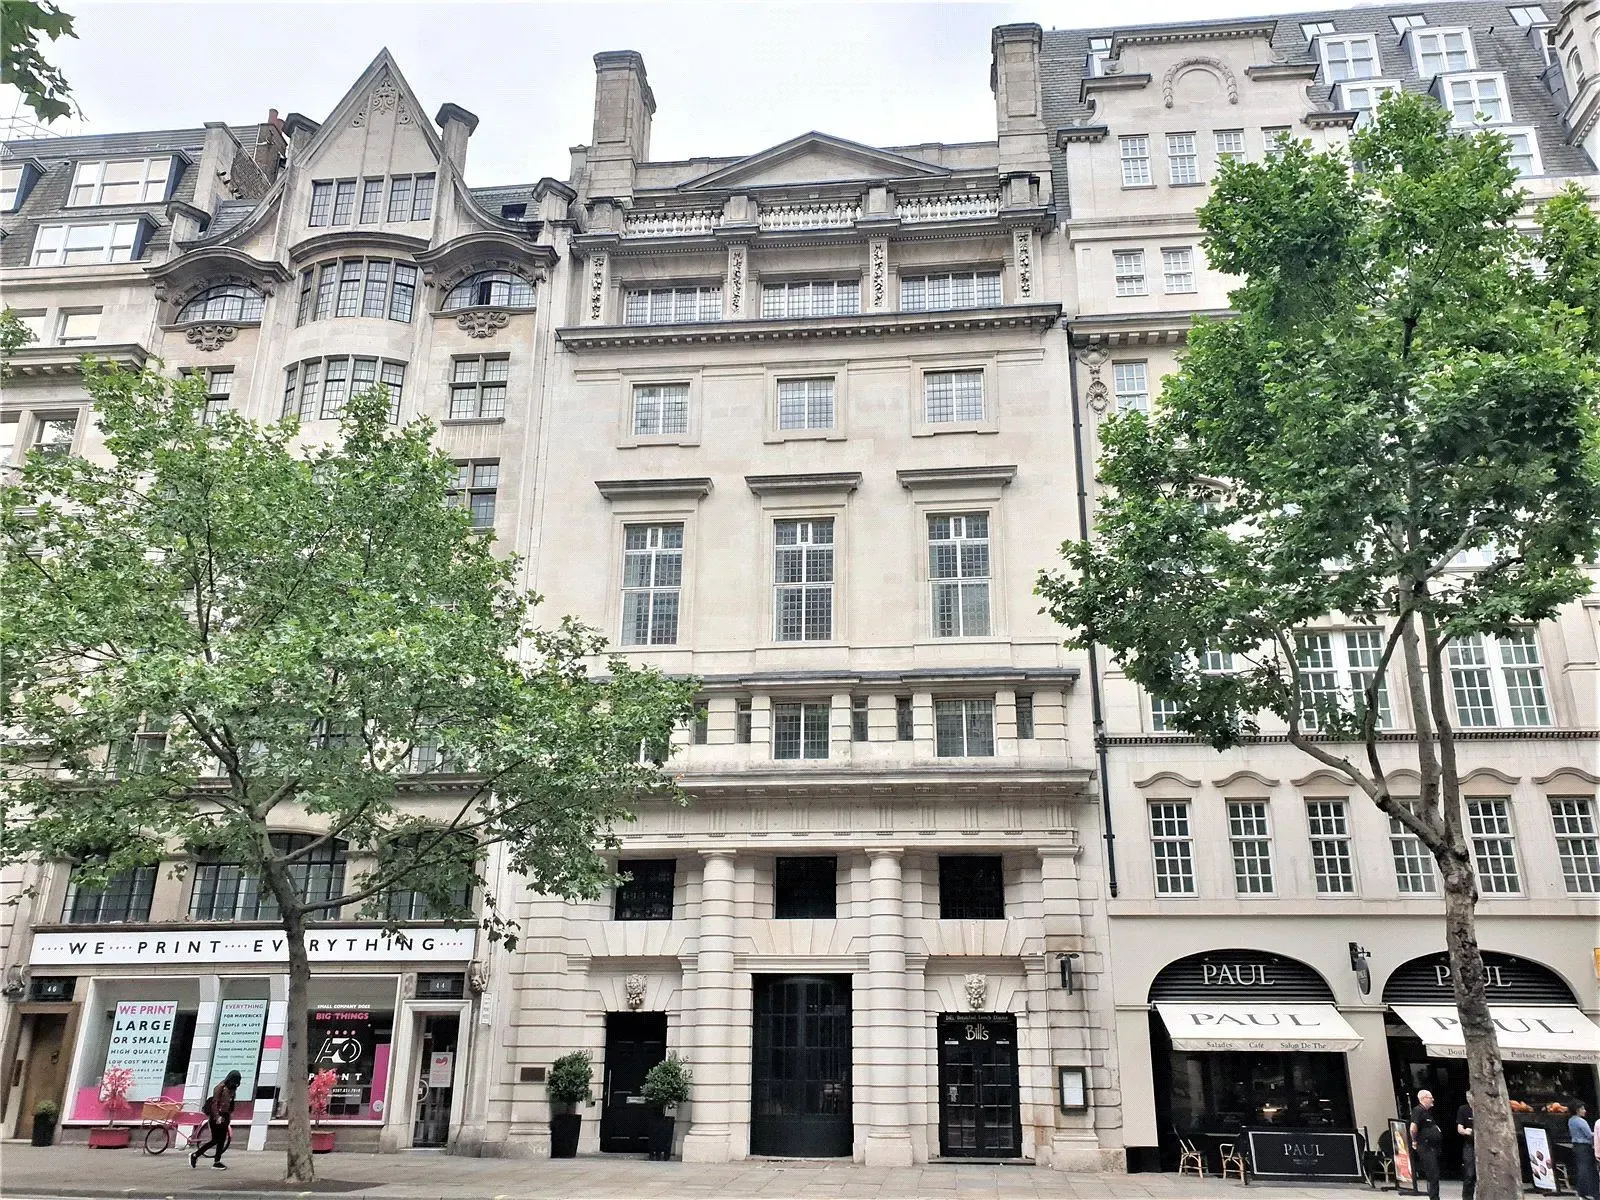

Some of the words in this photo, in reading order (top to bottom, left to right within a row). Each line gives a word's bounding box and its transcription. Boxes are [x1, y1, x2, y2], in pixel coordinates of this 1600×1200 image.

[69, 942, 104, 955] WE
[137, 940, 221, 954] PRINT
[253, 938, 435, 952] EVRYTHING
[1201, 964, 1275, 985] PAUL
[120, 1005, 137, 1015] WE
[139, 1005, 175, 1015] PRINT
[315, 1012, 331, 1020] BIG
[333, 1012, 369, 1020] THINGS
[115, 1020, 172, 1031] LARGE
[1189, 1013, 1321, 1026] PAUL
[1431, 1016, 1574, 1034] PUL
[965, 1023, 989, 1041] Bill's
[113, 1036, 128, 1044] OR
[132, 1036, 169, 1044] SMALL
[308, 1073, 362, 1081] PNT
[1283, 1143, 1325, 1156] PAUL
